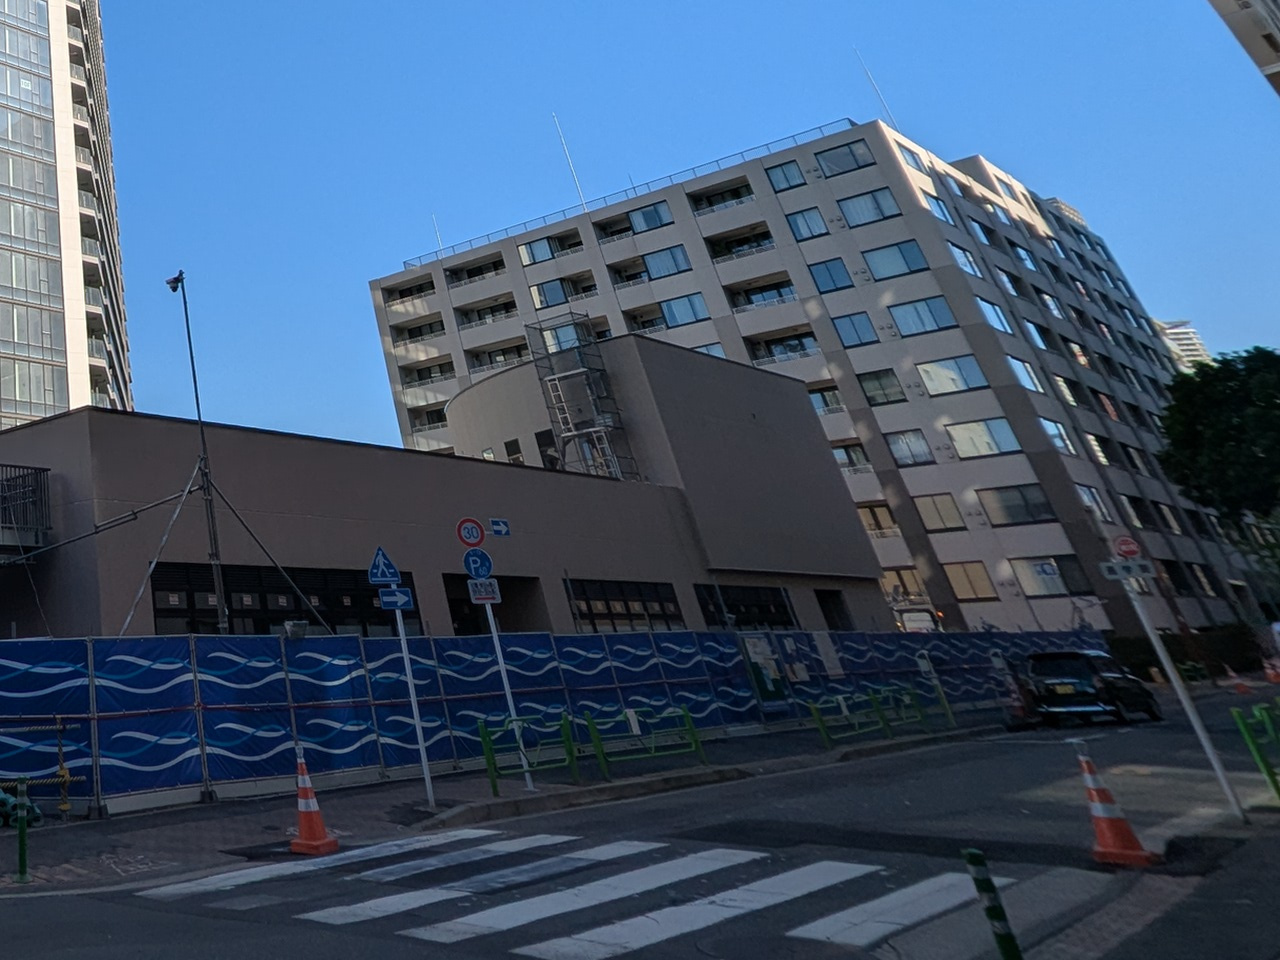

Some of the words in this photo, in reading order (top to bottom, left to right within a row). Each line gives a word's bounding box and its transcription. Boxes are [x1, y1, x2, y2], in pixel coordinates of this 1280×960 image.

[463, 526, 479, 540] 30
[469, 556, 481, 575] P
[478, 566, 488, 576] 60
